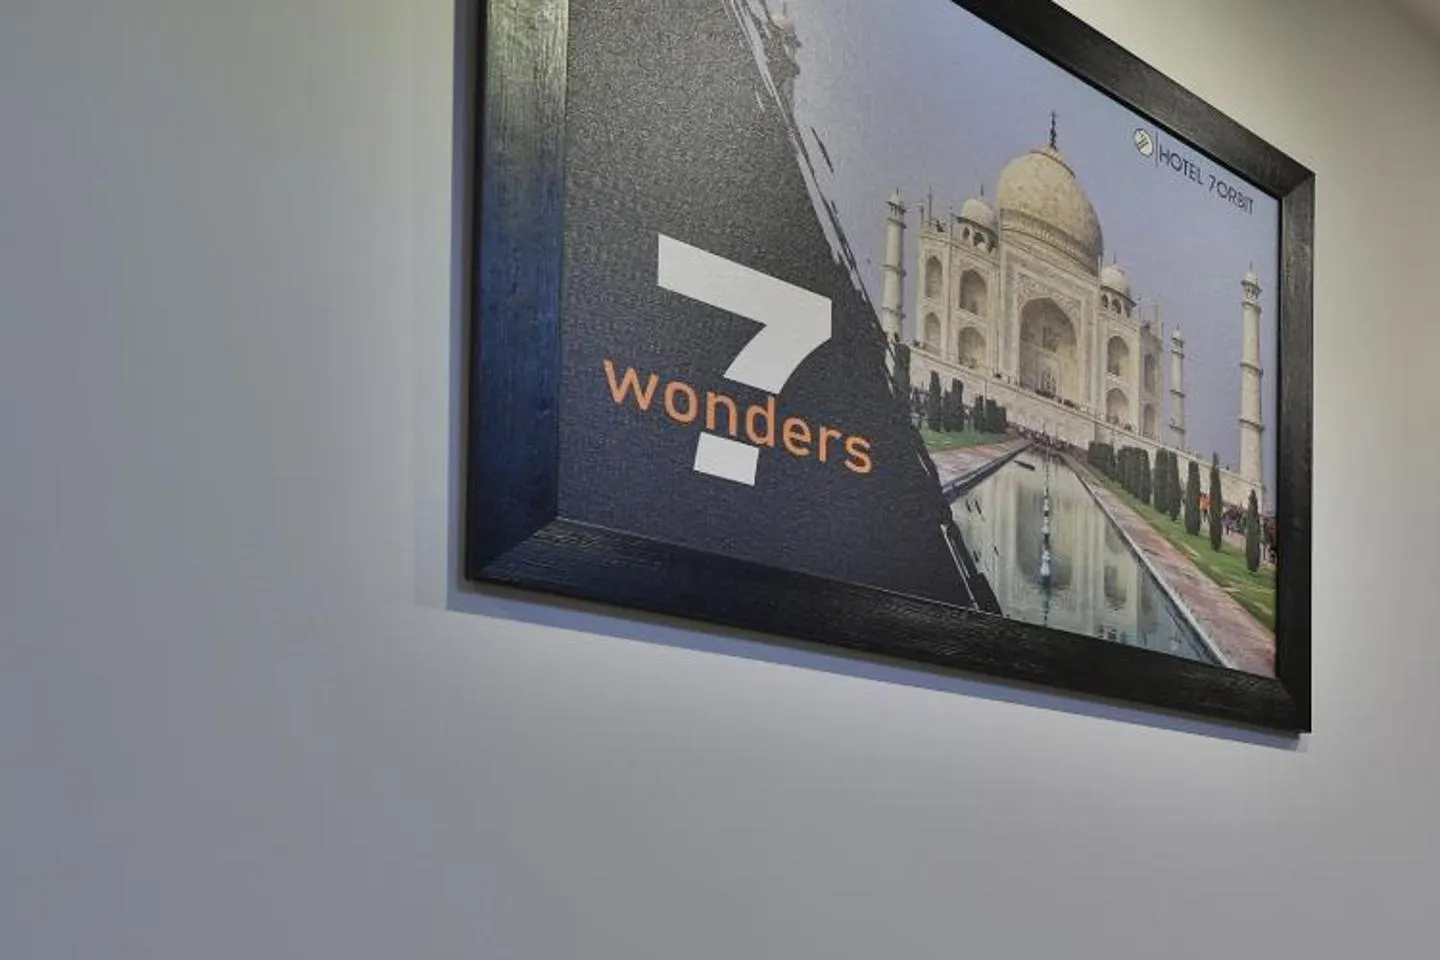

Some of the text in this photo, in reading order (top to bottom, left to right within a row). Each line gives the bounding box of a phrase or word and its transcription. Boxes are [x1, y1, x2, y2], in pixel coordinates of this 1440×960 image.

[1158, 144, 1254, 215] HOTEL 7ORBIT
[603, 358, 874, 474] wonders
[656, 233, 832, 486] 7
